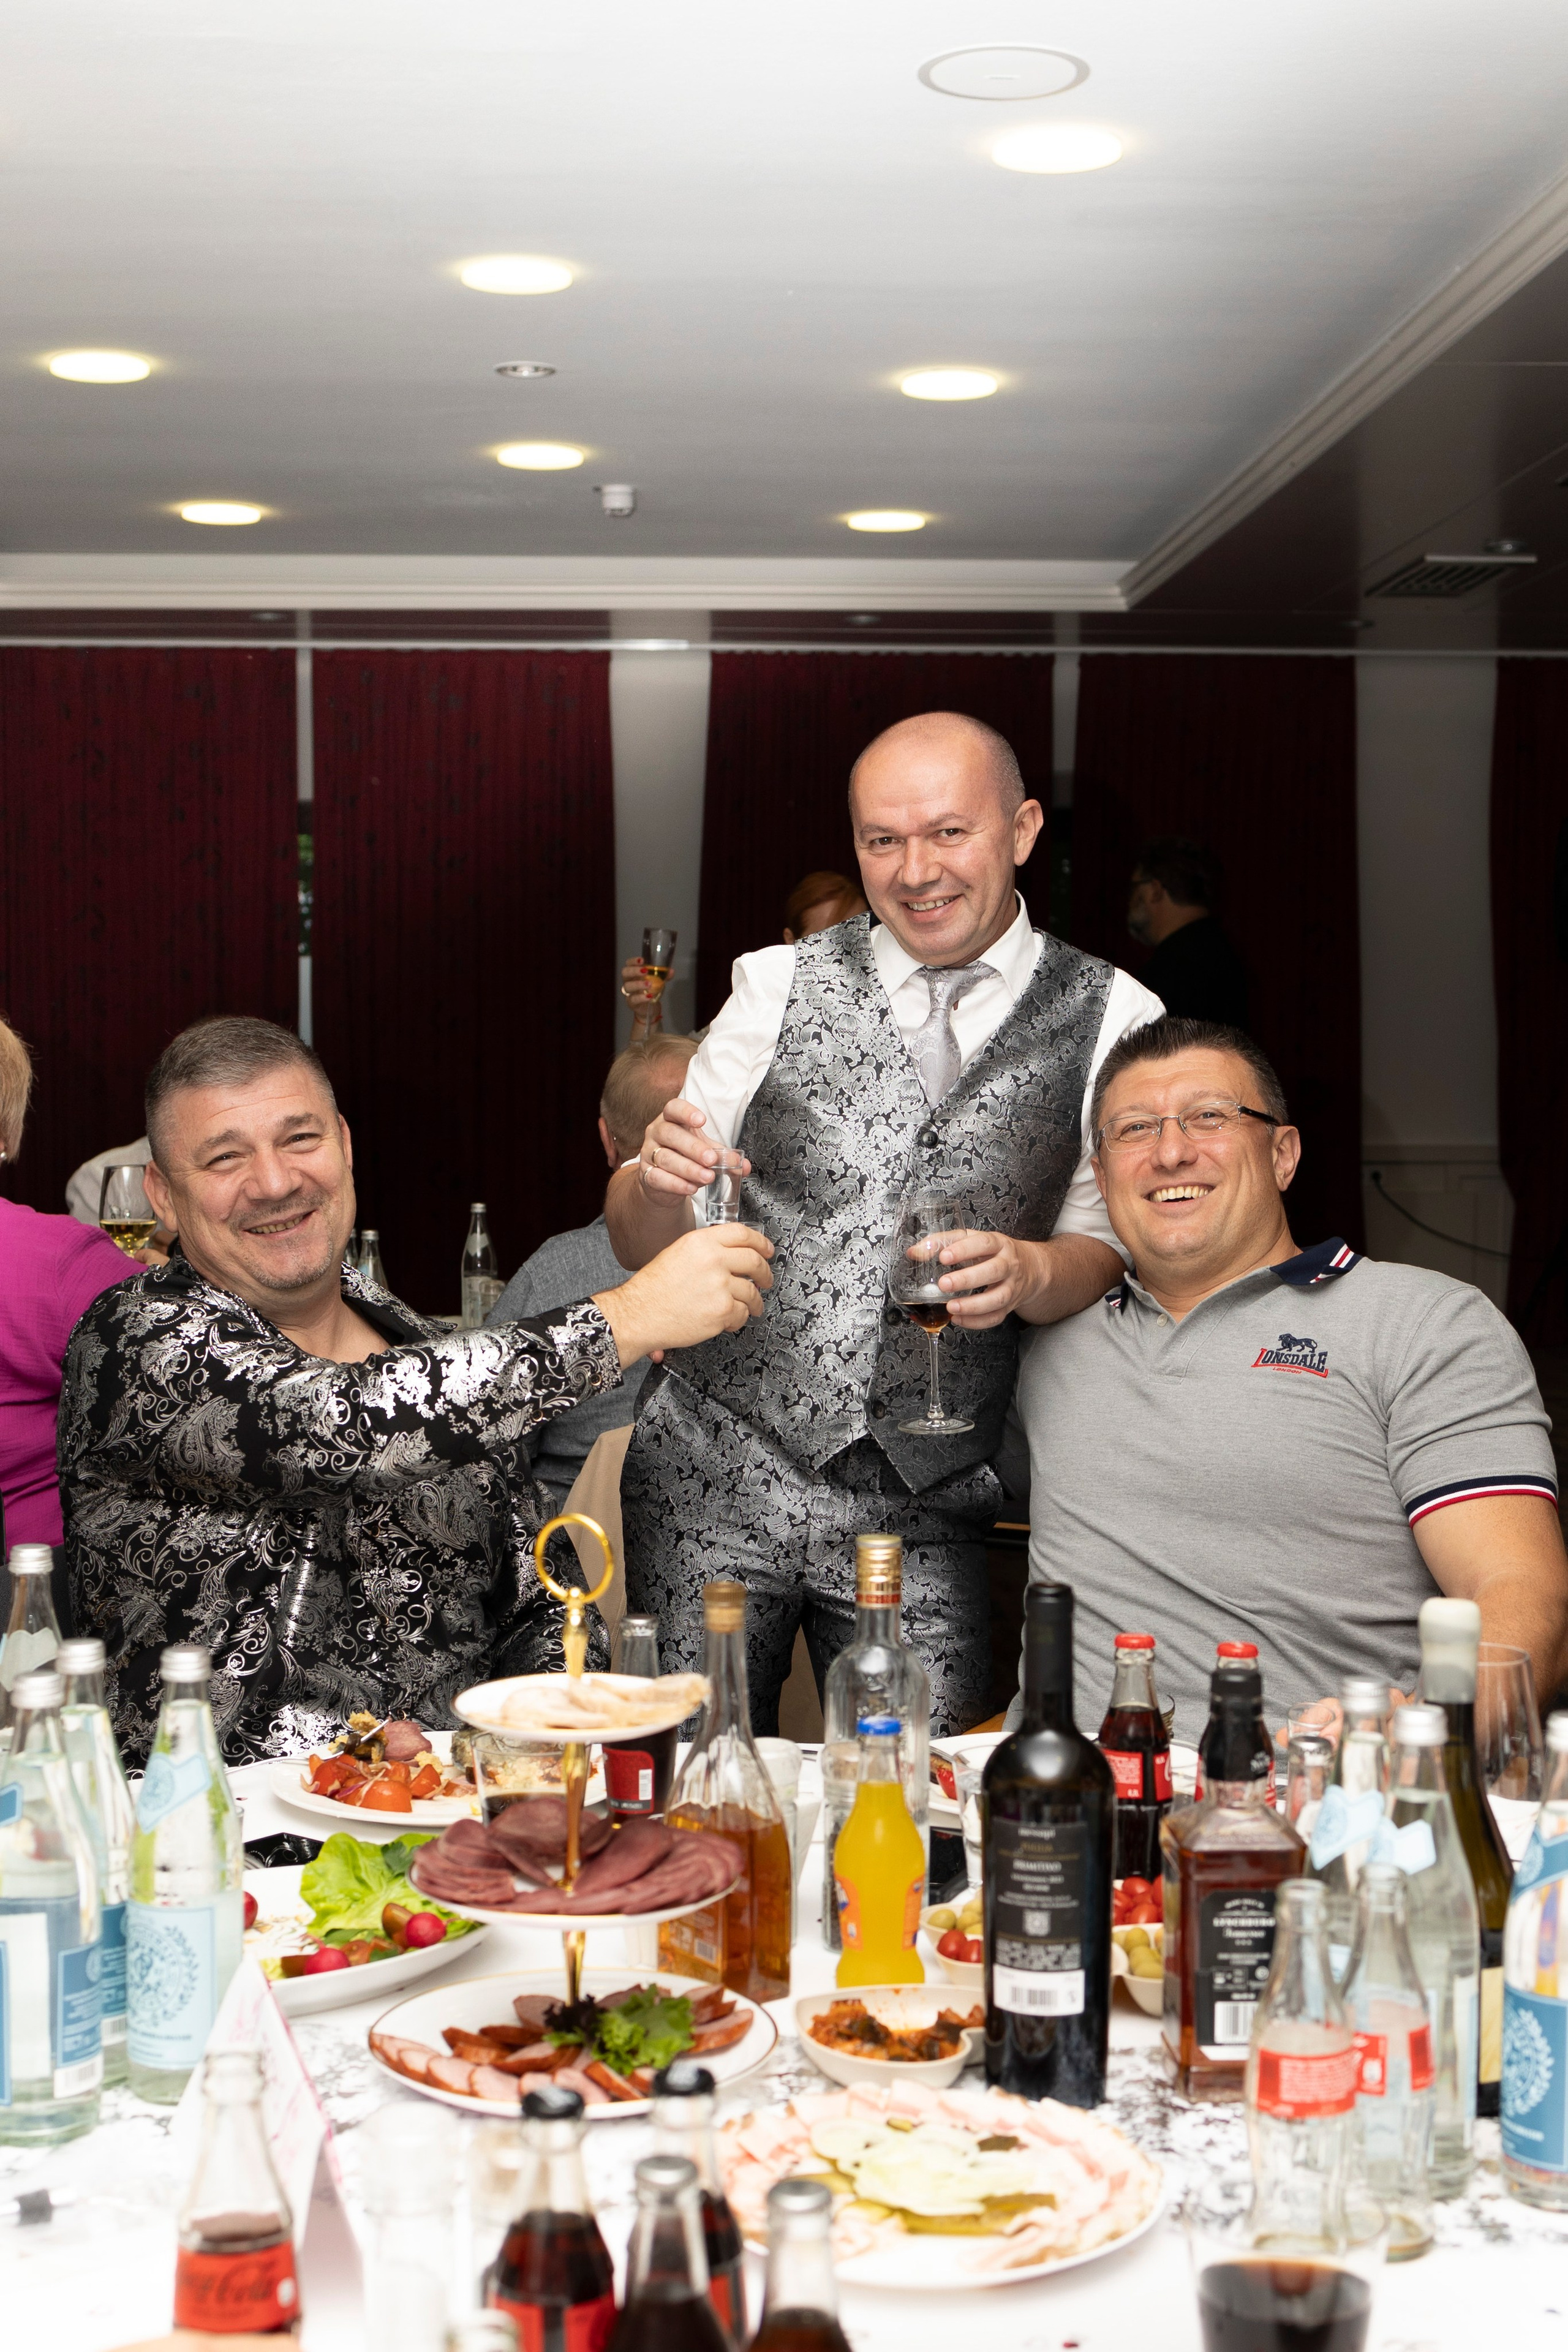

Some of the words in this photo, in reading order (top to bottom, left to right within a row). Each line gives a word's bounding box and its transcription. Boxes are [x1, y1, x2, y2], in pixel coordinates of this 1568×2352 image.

[1251, 1348, 1329, 1378] LONSDALE
[1014, 1859, 1061, 1872] PRIMITIVO
[1213, 1918, 1275, 1927] LYNCHBURG
